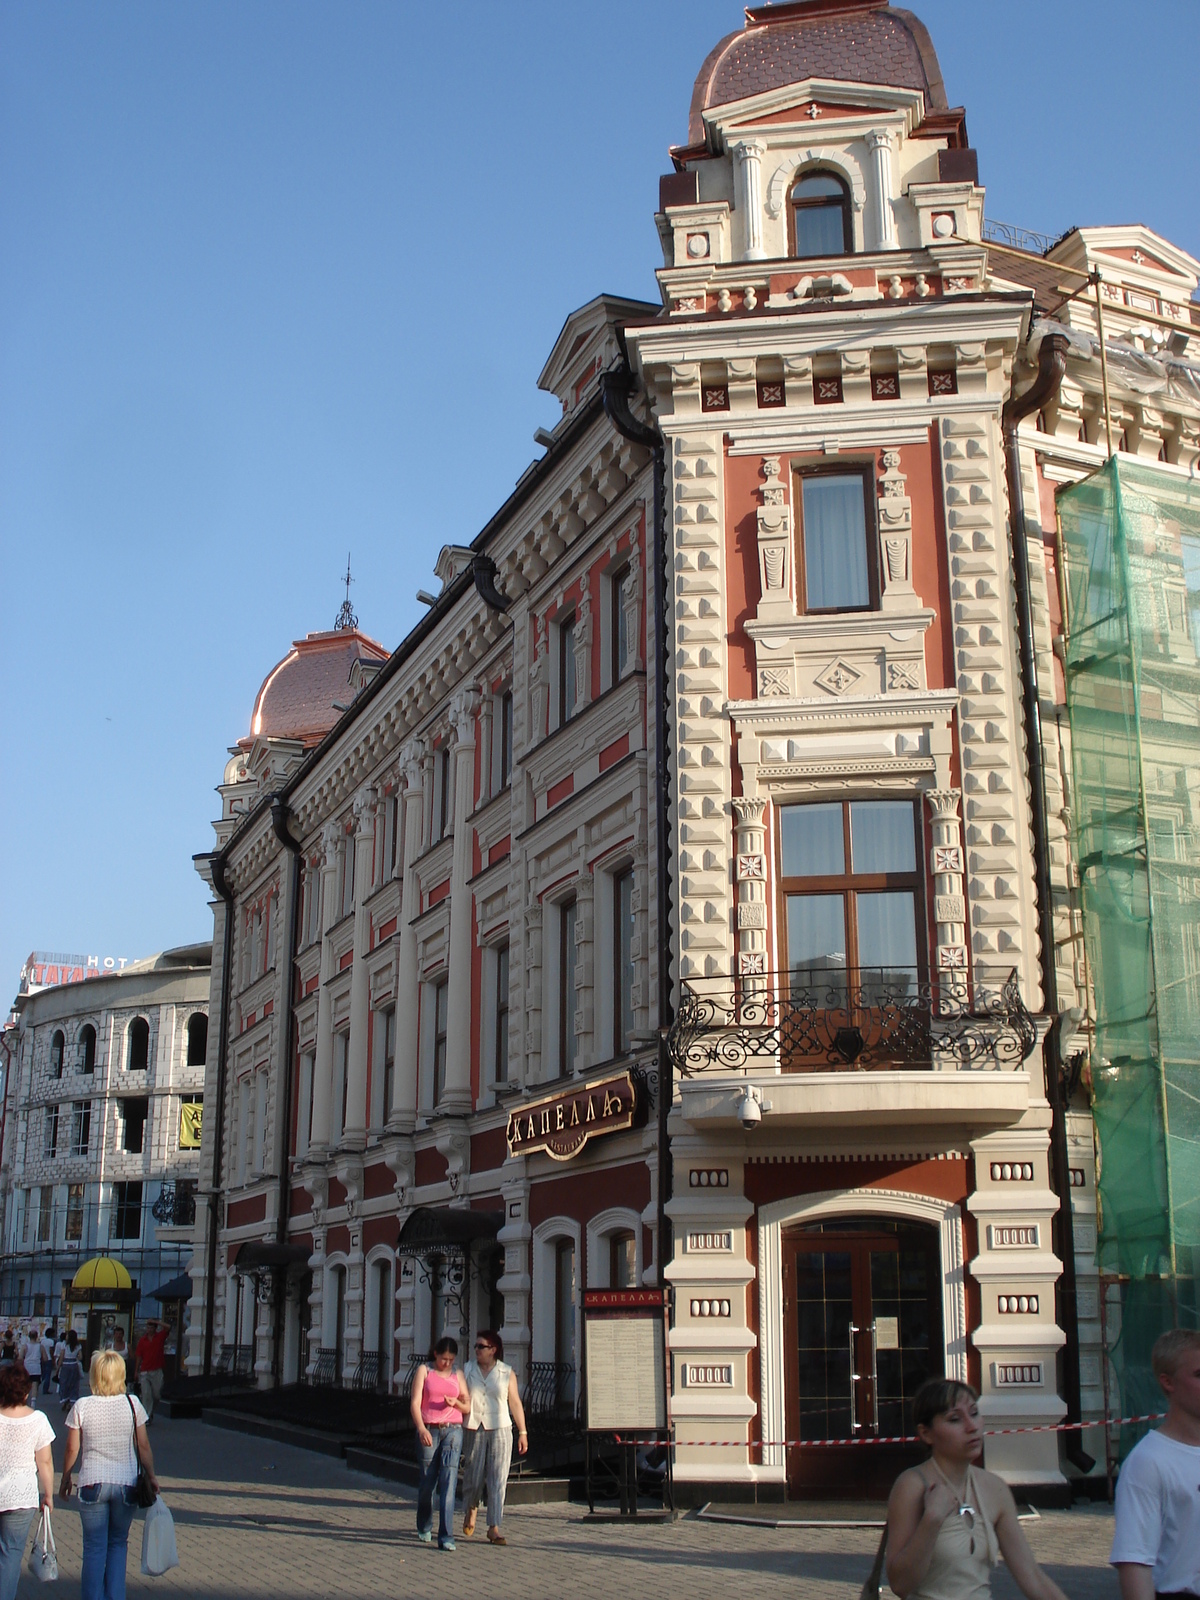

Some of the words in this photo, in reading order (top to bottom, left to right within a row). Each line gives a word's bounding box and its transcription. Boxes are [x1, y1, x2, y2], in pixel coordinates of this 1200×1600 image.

[87, 955, 141, 969] HOT
[508, 1090, 622, 1142] КАПЕЛЛА
[586, 1293, 660, 1303] КАПЕЛЛА
